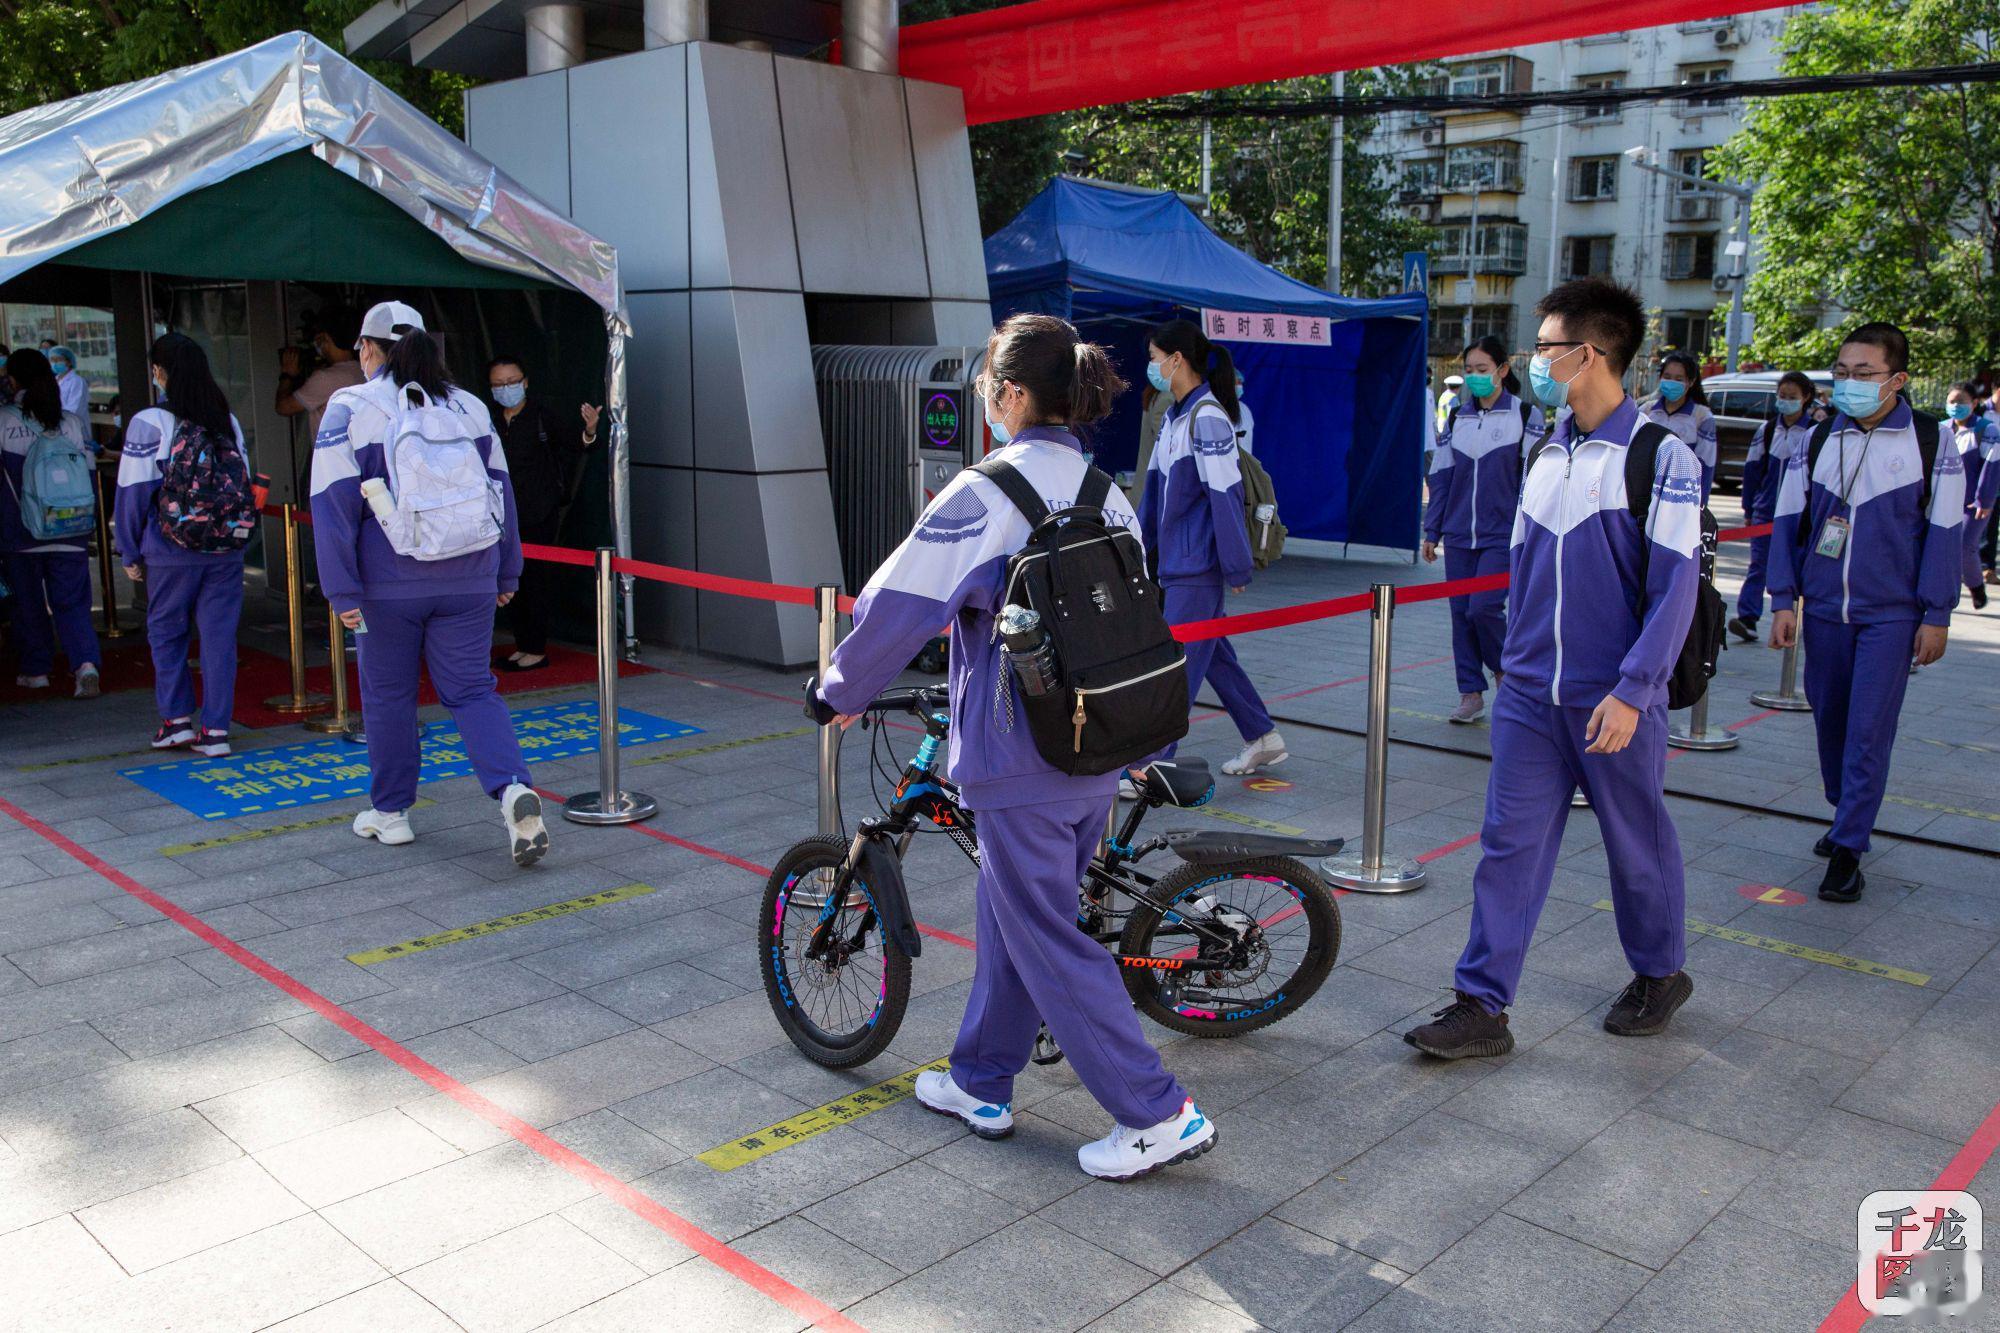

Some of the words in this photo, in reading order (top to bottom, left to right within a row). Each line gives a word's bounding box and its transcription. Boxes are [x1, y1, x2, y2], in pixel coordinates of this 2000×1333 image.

[1212, 313, 1322, 340] 临时观察点
[926, 411, 957, 427] 出入平安
[1122, 956, 1184, 970] TOYOU
[790, 1121, 836, 1139] Please
[839, 1105, 871, 1121] Wait
